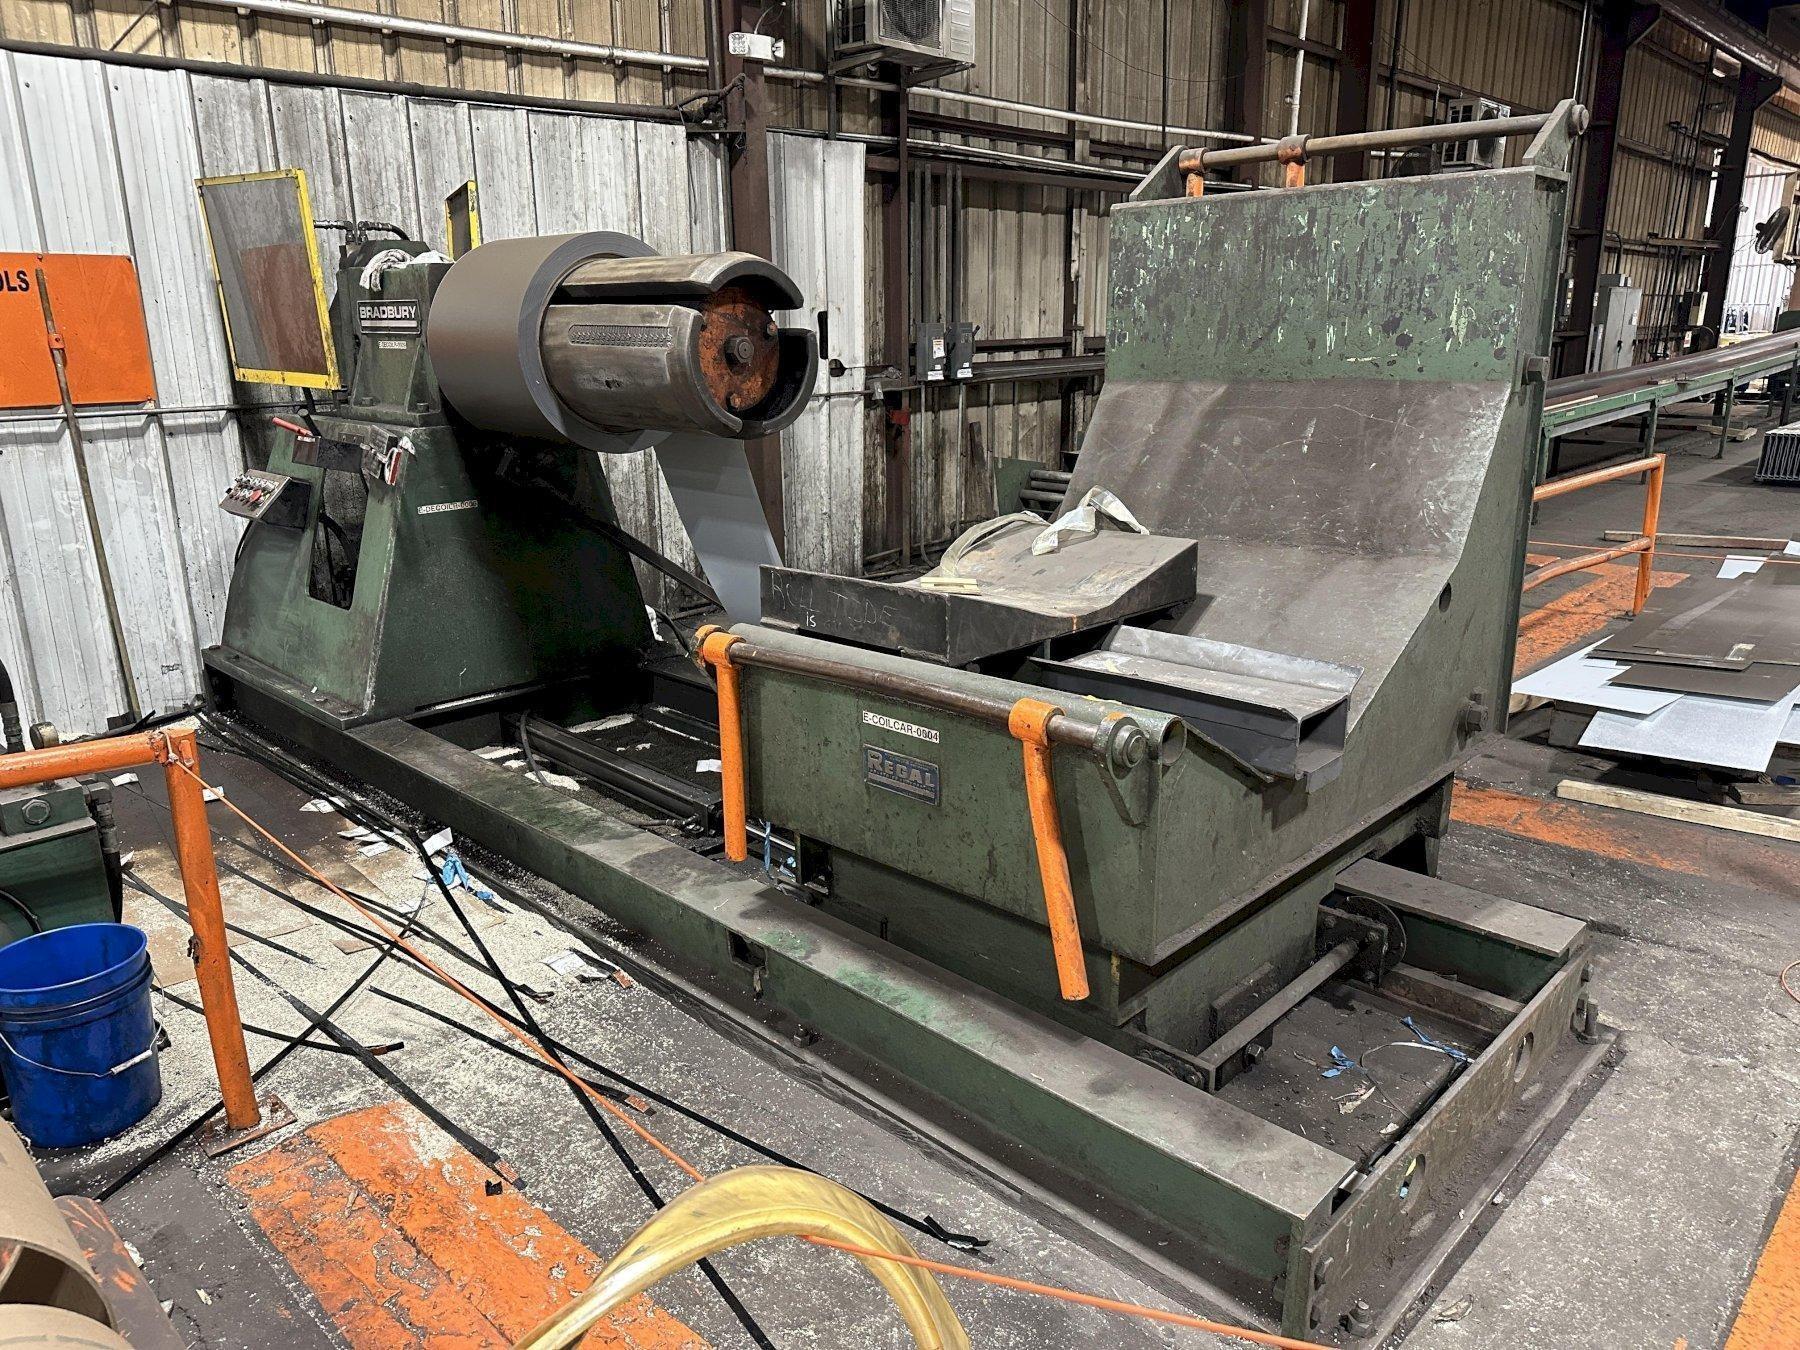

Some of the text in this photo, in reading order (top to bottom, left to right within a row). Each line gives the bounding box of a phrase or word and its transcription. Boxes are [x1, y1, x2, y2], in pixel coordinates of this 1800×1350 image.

[359, 305, 417, 319] BRADBURY
[806, 611, 817, 628] is
[868, 749, 936, 789] REGAL
